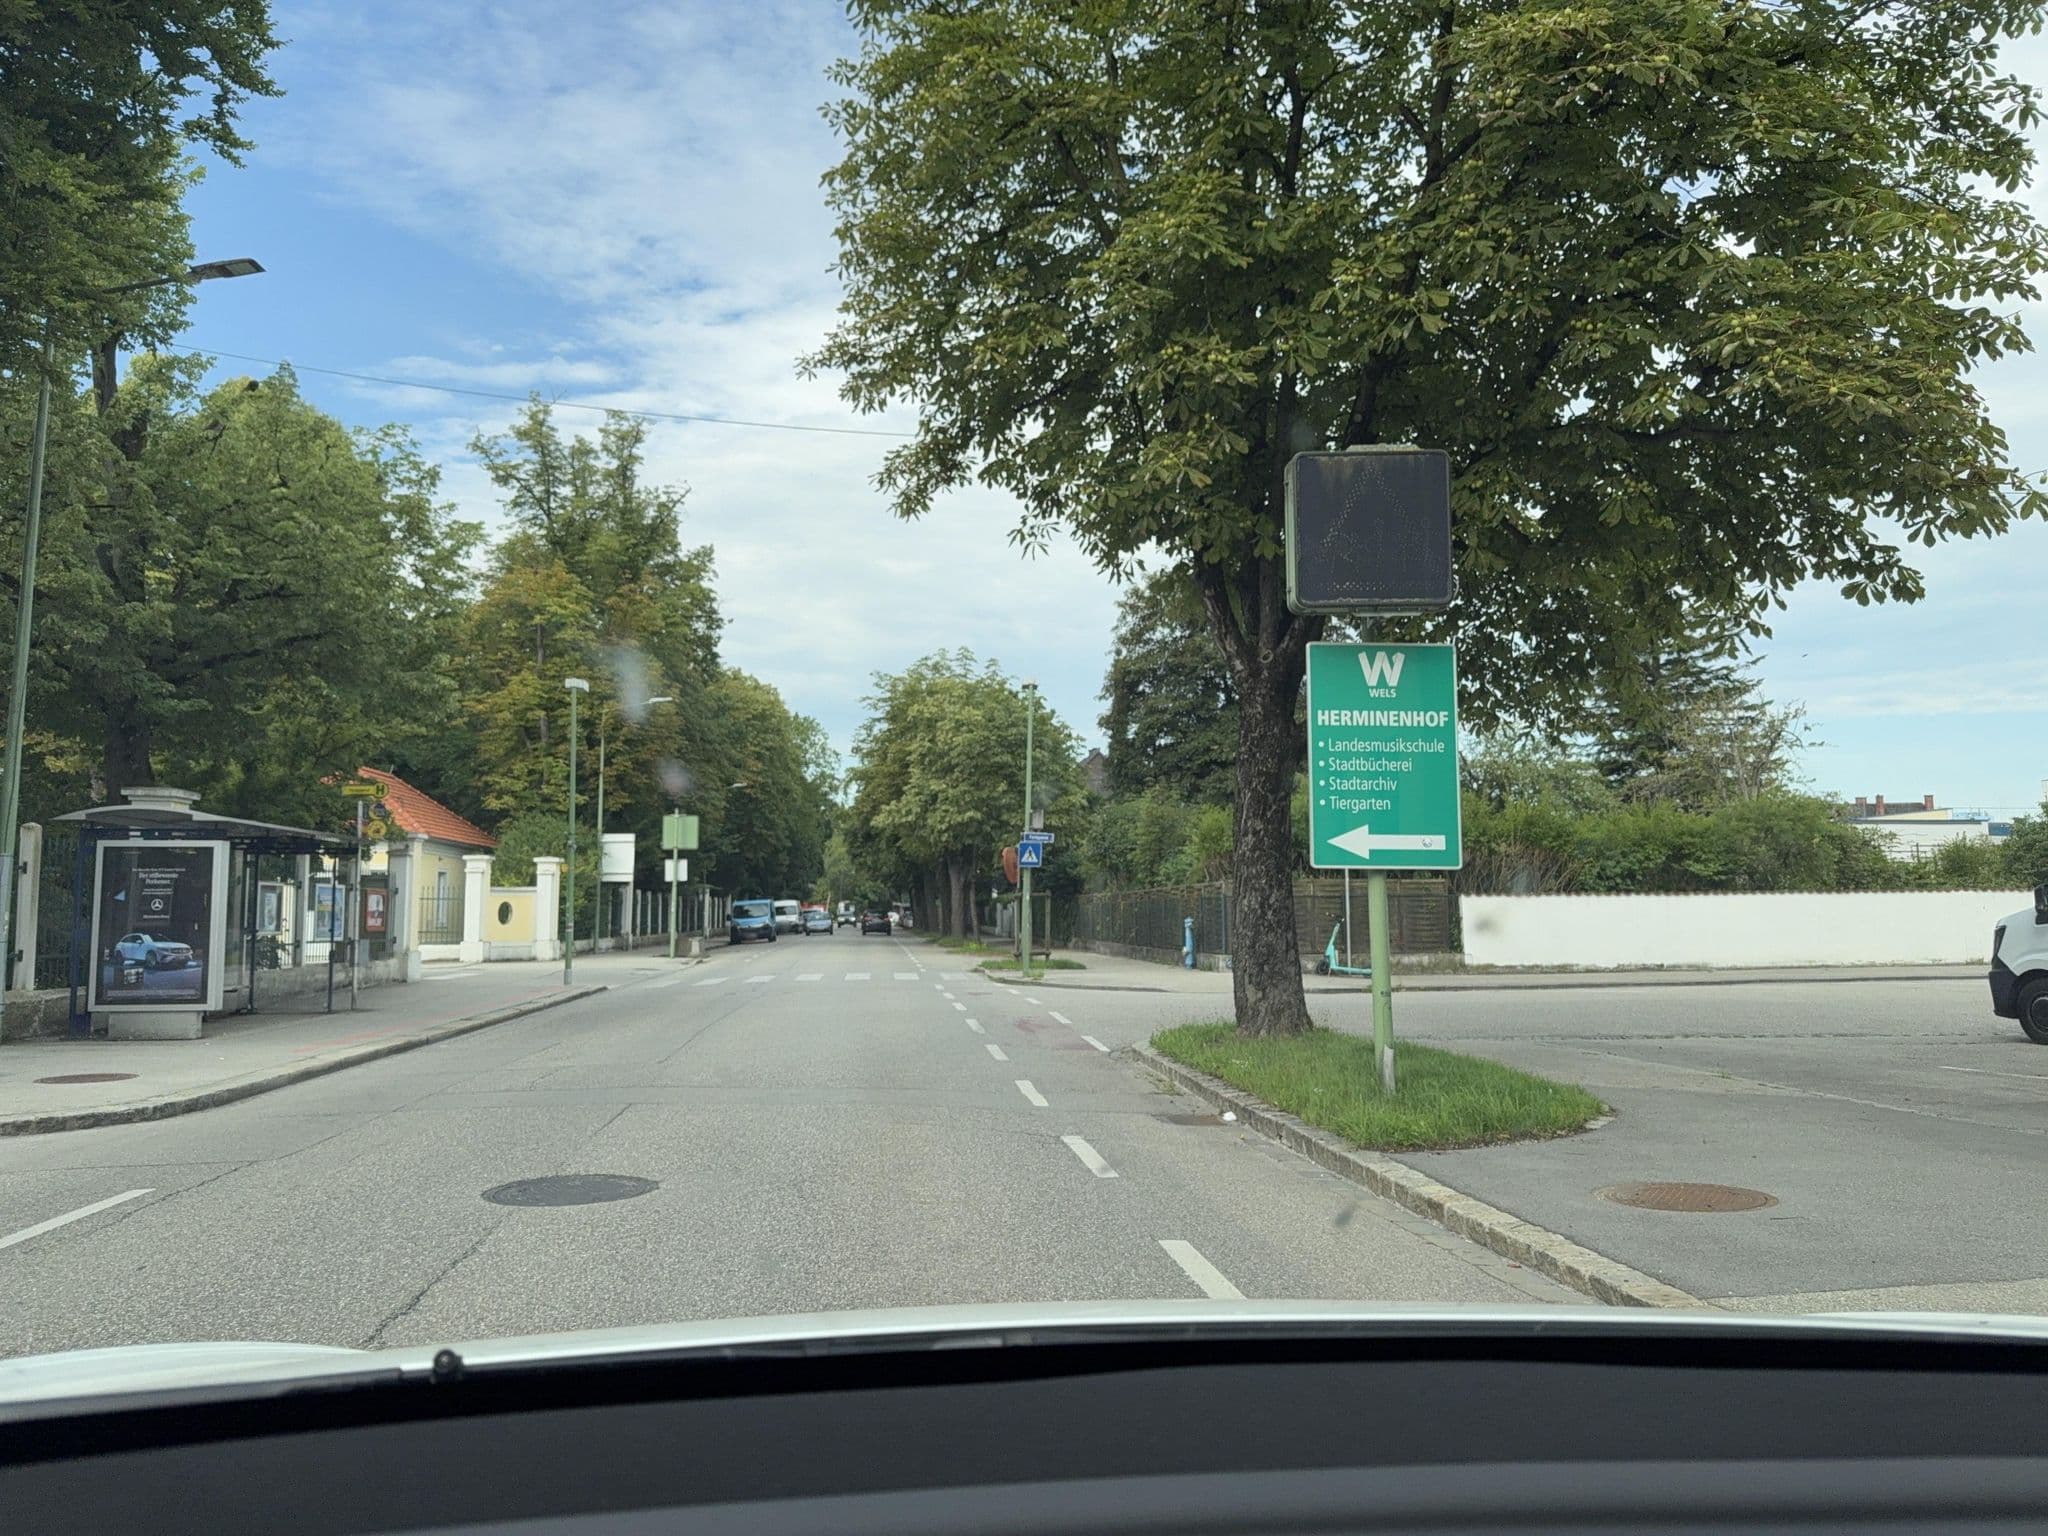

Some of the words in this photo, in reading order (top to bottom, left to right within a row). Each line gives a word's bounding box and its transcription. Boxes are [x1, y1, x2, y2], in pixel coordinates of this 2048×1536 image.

[1358, 651, 1405, 687] W
[1369, 688, 1396, 698] WELS
[1317, 710, 1448, 727] HERMINENHOF
[1328, 738, 1444, 753] Landesmusikschule
[1329, 757, 1412, 772] Stadtbücherei
[376, 785, 384, 795] H
[1329, 777, 1397, 791] Stadtarchiv
[1330, 797, 1391, 813] Tiergarten
